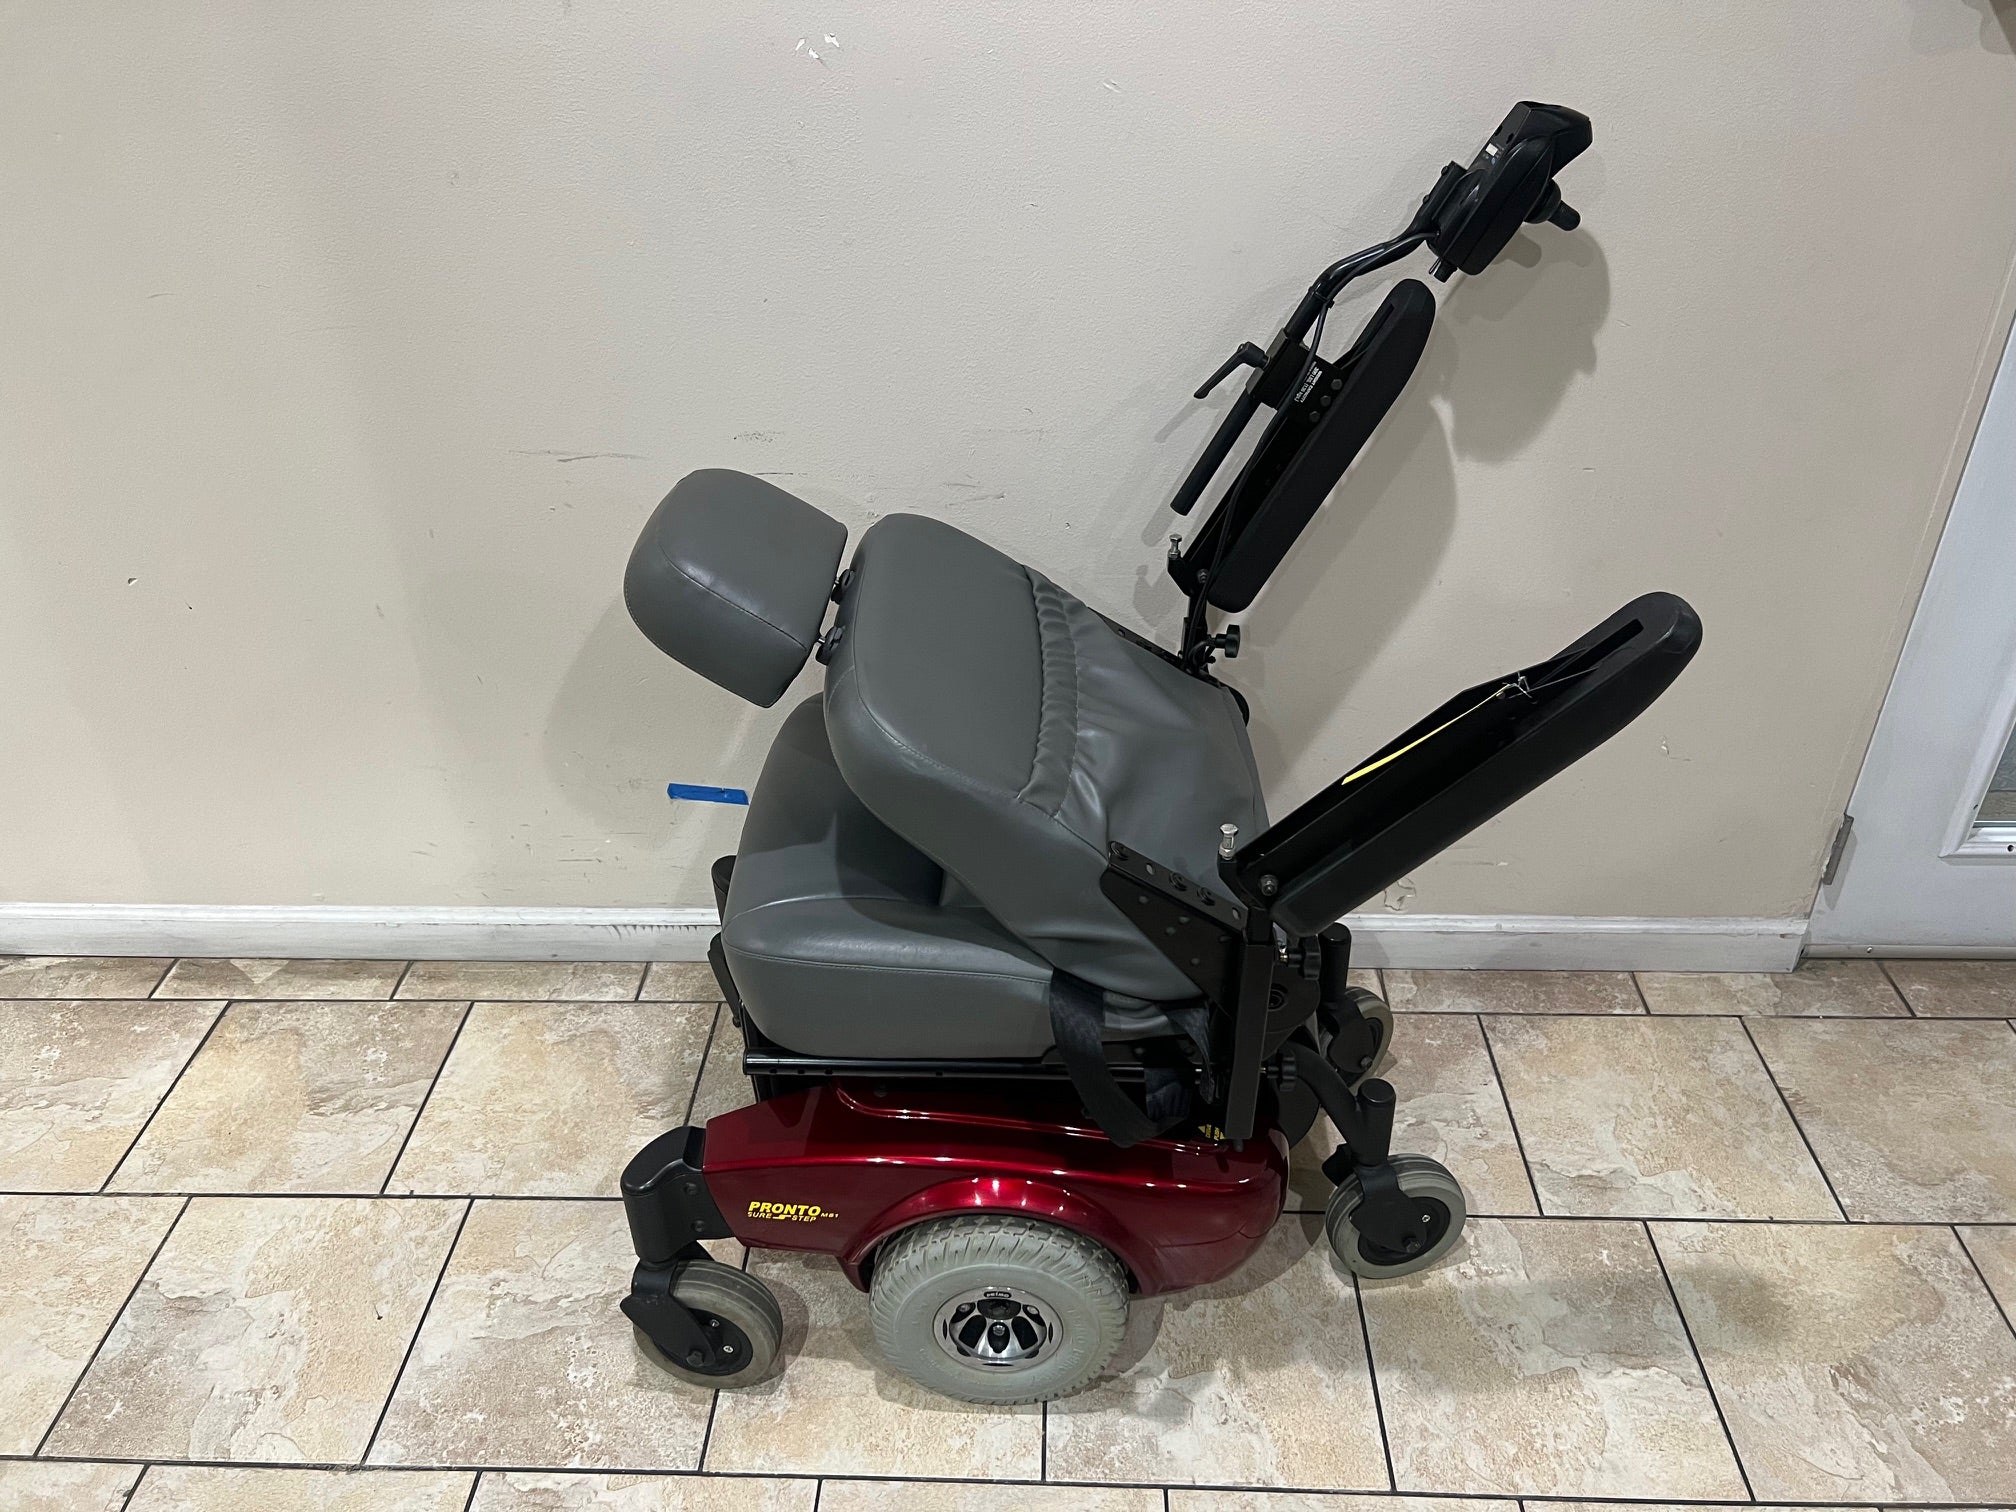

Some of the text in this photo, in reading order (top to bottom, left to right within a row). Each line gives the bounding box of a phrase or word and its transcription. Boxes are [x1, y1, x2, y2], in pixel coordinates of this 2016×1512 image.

[748, 1201, 821, 1217] PRONTO
[747, 1211, 817, 1222] SURE STEP
